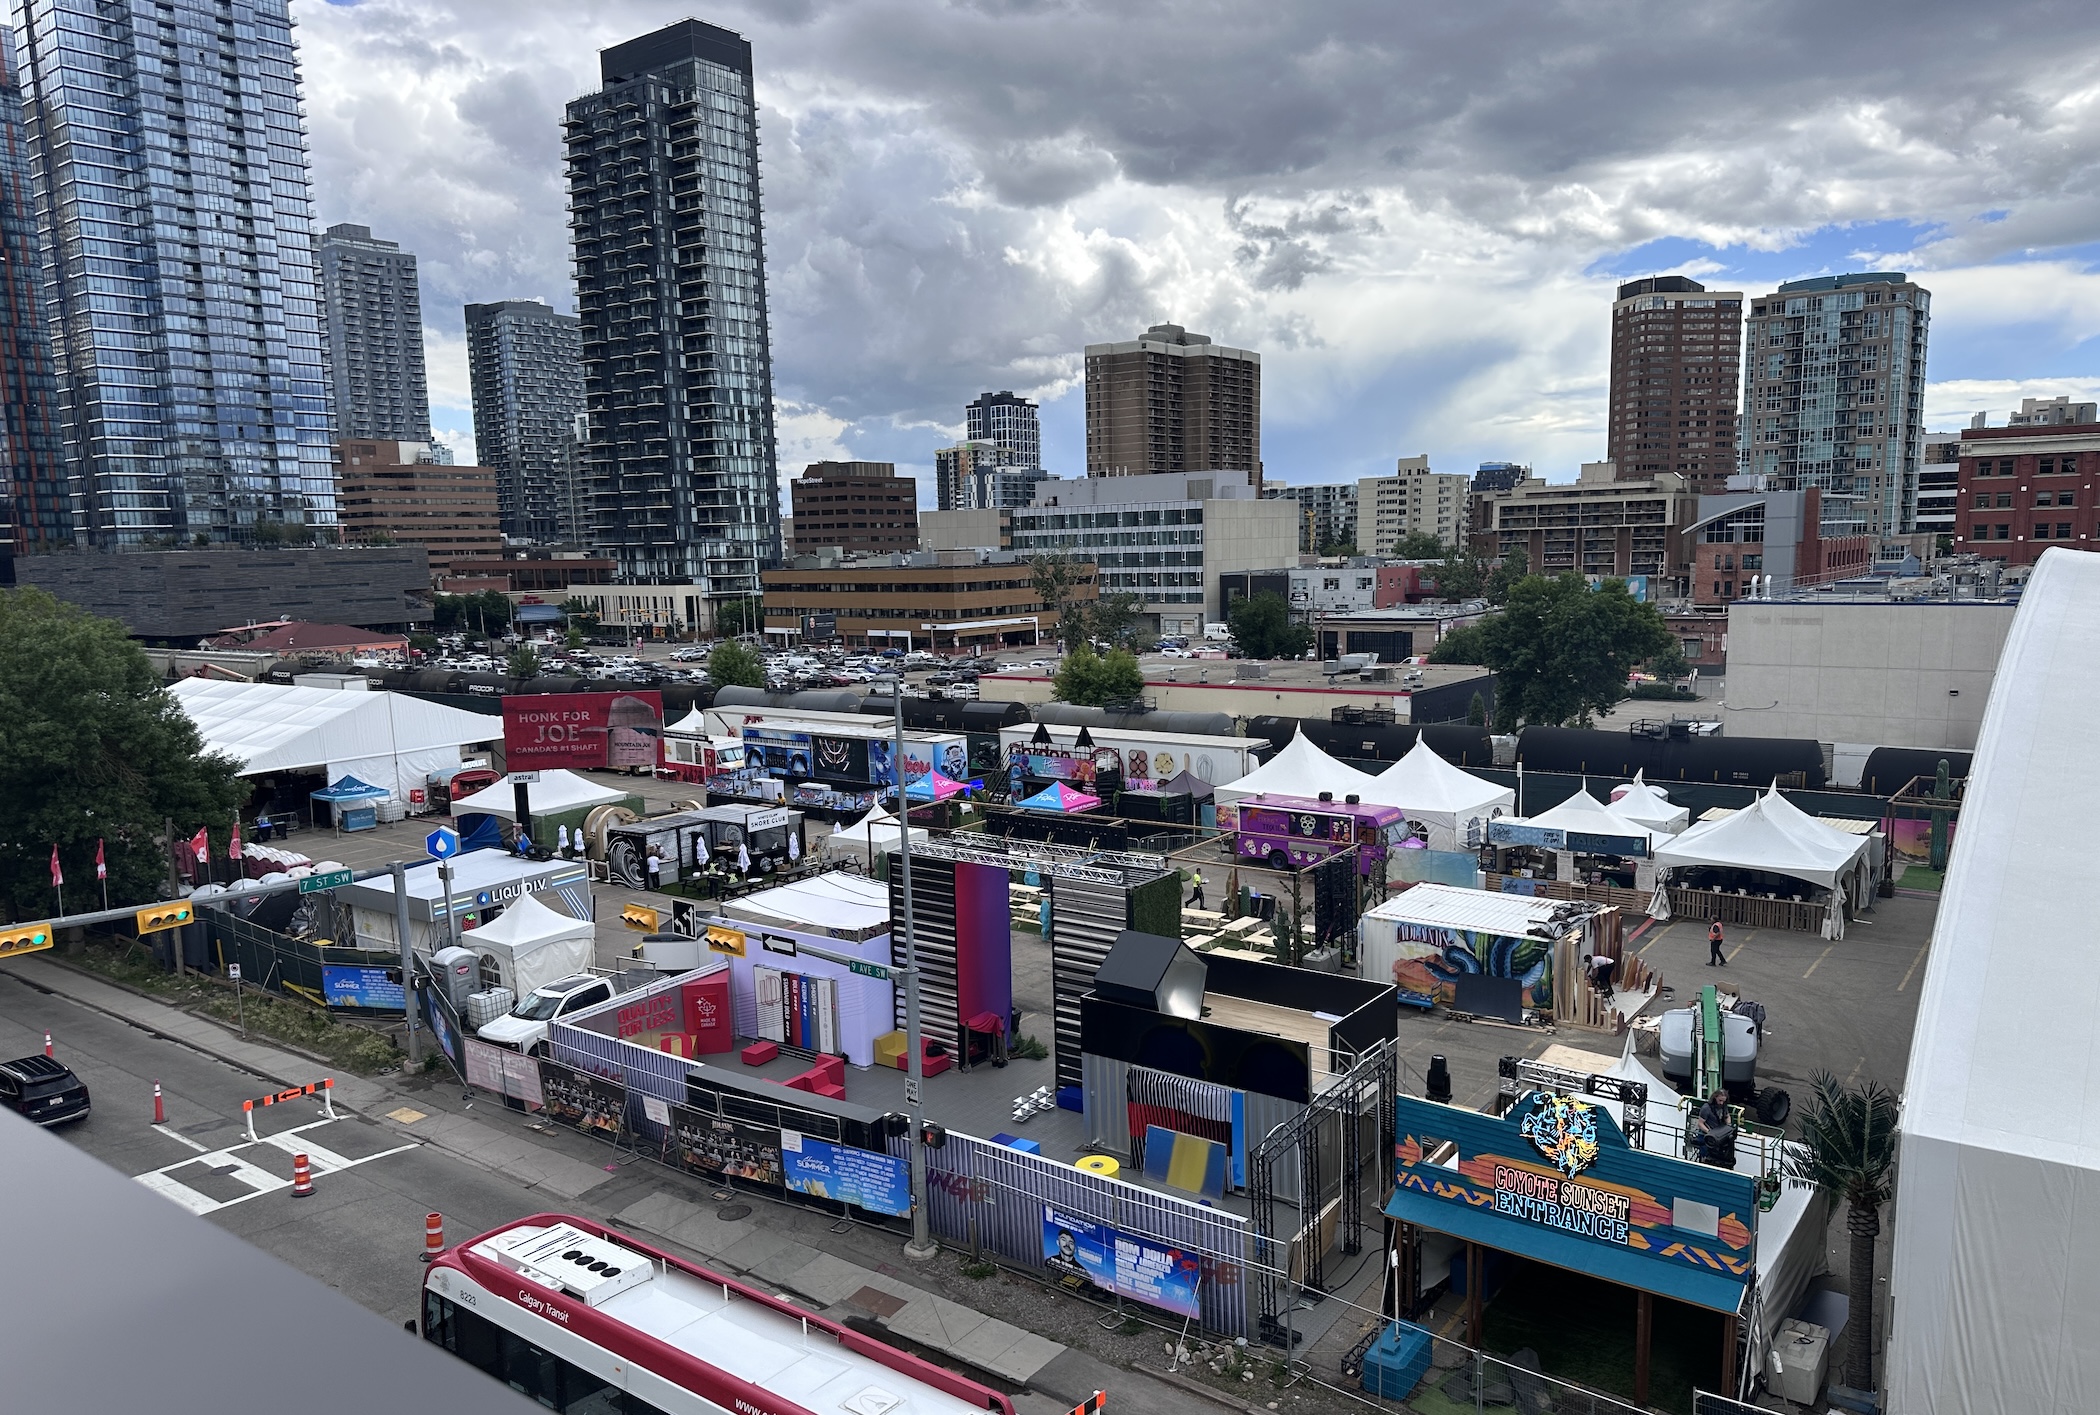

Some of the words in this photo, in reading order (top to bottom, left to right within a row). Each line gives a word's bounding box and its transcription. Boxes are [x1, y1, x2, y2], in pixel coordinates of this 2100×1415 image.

[368, 678, 383, 686] OCOR
[468, 684, 494, 693] PROCOR
[519, 713, 559, 723] HONK
[562, 711, 590, 722] FOR
[533, 724, 580, 743] JOE
[516, 745, 557, 754] CANADA'S
[571, 743, 598, 751] SHAFT
[513, 773, 534, 781] astral
[751, 819, 770, 828] SHORE
[302, 880, 309, 890] 7
[316, 876, 329, 888] ST
[334, 872, 350, 884] SW
[851, 961, 856, 971] 9
[859, 964, 872, 975] AVE
[875, 967, 886, 978] SW
[617, 994, 673, 1024] QUALITY+
[618, 1020, 643, 1040] FOR
[646, 1007, 676, 1031] LESS
[906, 1080, 917, 1089] ONE
[906, 1088, 917, 1096] WAY
[796, 1159, 831, 1174] SUMMER
[1495, 1165, 1558, 1204] COYOTE
[1560, 1182, 1629, 1221] SUNSET
[1494, 1188, 1629, 1246] ENTRANCE
[460, 1289, 477, 1306] 8223
[518, 1289, 544, 1313] Calgary
[546, 1302, 570, 1323] Transit
